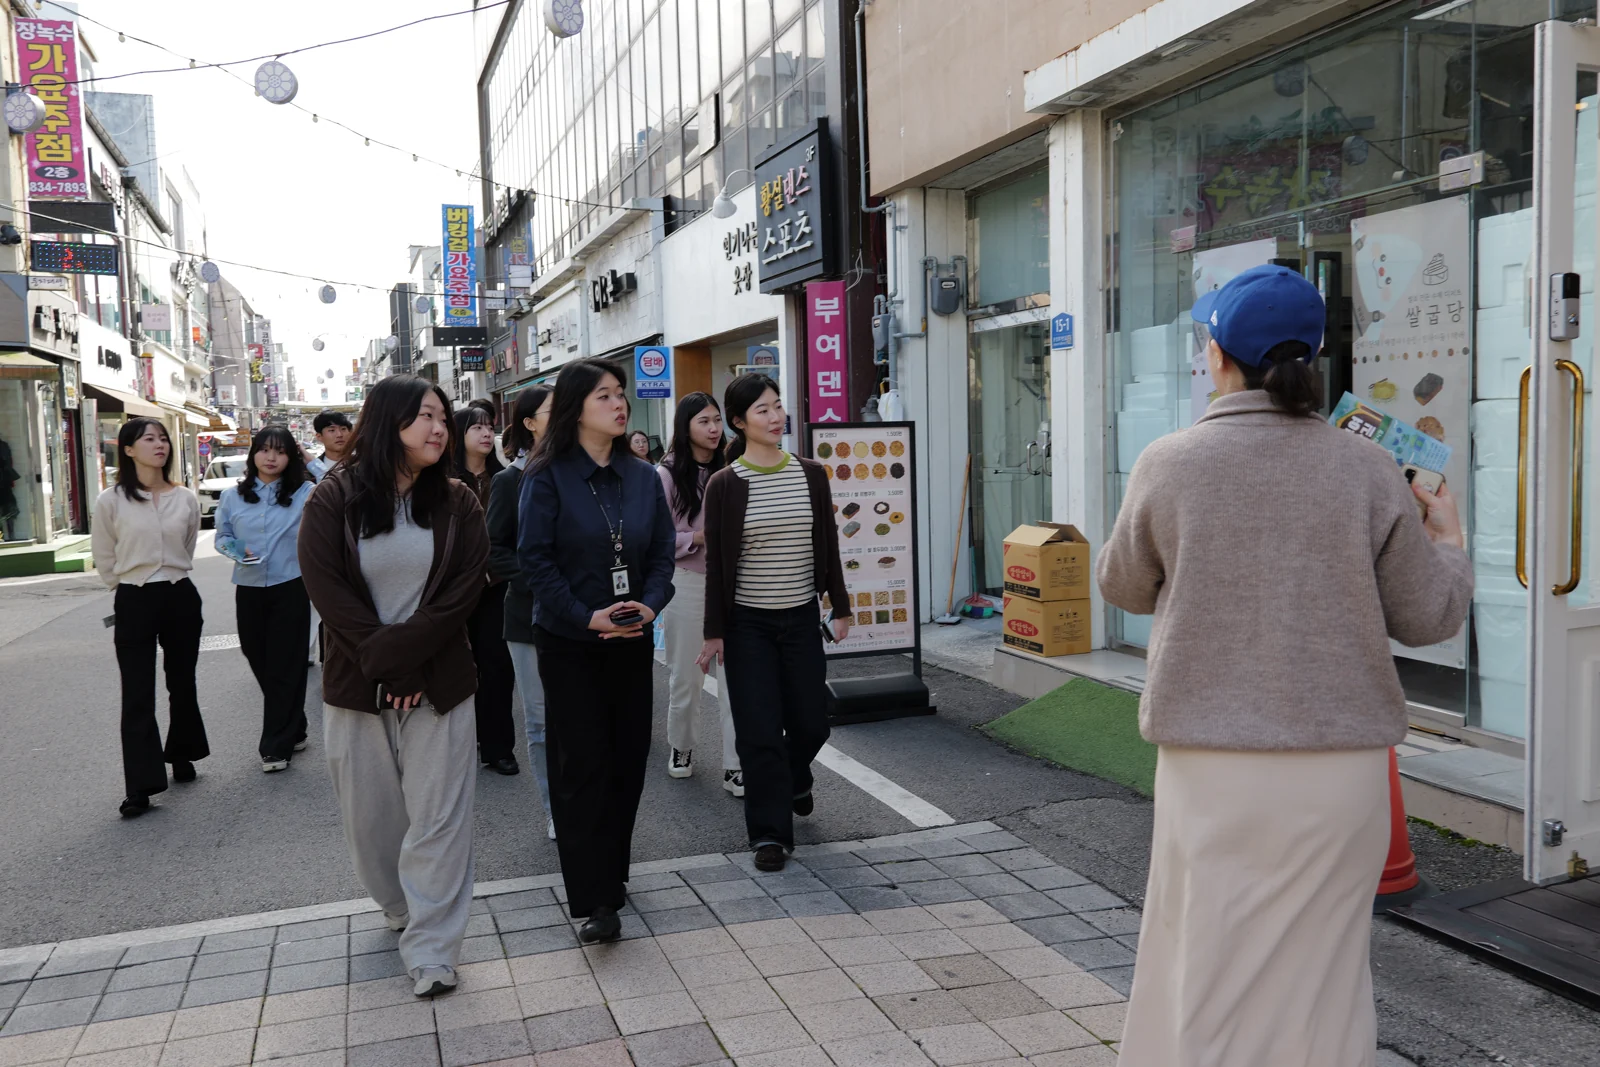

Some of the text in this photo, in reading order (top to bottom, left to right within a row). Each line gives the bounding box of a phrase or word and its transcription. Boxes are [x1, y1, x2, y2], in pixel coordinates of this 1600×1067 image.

[17, 21, 74, 43] 장녹수
[27, 43, 74, 163] 가요주점
[805, 144, 816, 163] 3F
[44, 166, 70, 179] 2층
[29, 181, 87, 194] 834-7893
[446, 206, 469, 252] 버킹검
[761, 210, 815, 265] 스포츠
[447, 251, 471, 308] 가요주점
[732, 261, 753, 296] 옷장
[1055, 317, 1070, 333] 15-1
[1405, 300, 1465, 328] 쌀굽당
[643, 356, 663, 367] 담배
[813, 297, 843, 422] 부여댄스
